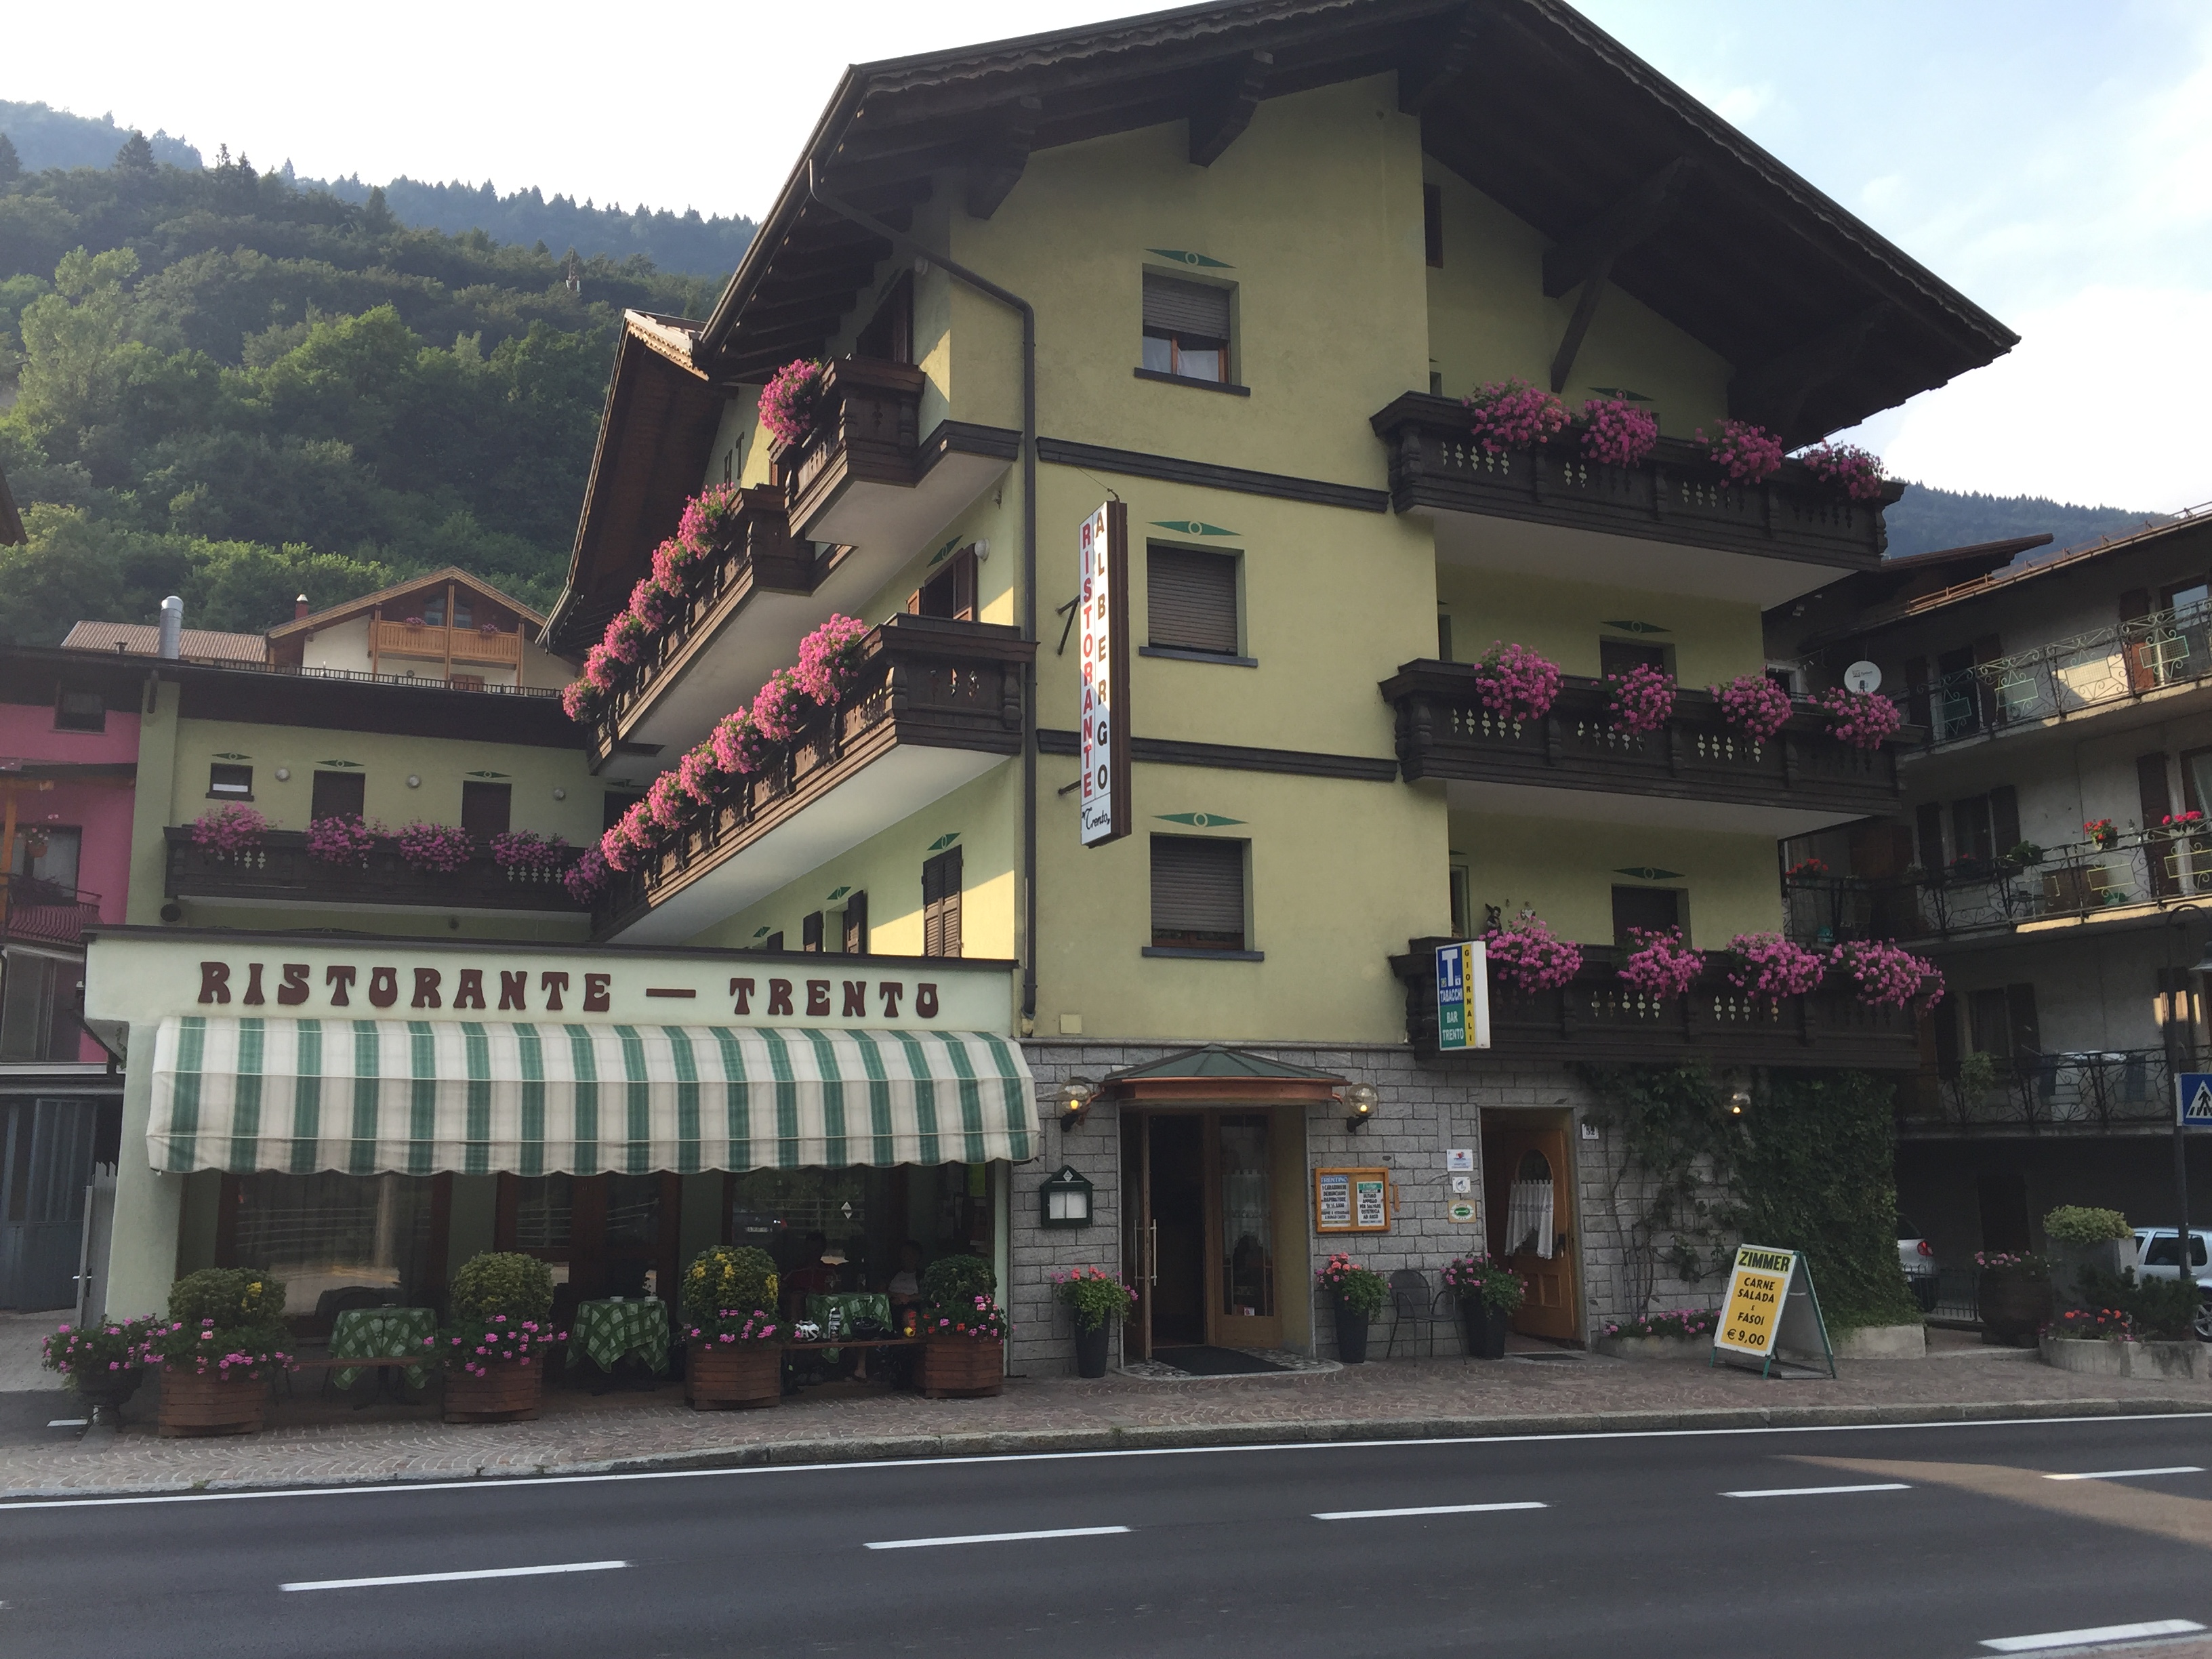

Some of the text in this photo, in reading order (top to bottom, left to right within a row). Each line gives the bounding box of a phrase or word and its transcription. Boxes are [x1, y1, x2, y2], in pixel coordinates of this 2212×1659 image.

[1095, 512, 1107, 790] ALBERGO
[1082, 523, 1092, 798] RISTORANTE
[197, 961, 611, 1012] RISTORANTE
[729, 977, 939, 1019] TRENTO
[1440, 987, 1463, 1003] TABACCHI
[1464, 949, 1473, 1042] GIORNALI
[1446, 1010, 1458, 1023] BAR
[1442, 1027, 1465, 1041] TRENTO
[1738, 1251, 1790, 1272] ZIMMER
[1744, 1277, 1776, 1291] CARNE
[1737, 1288, 1775, 1304] SALADA
[1737, 1312, 1765, 1326] FASOI
